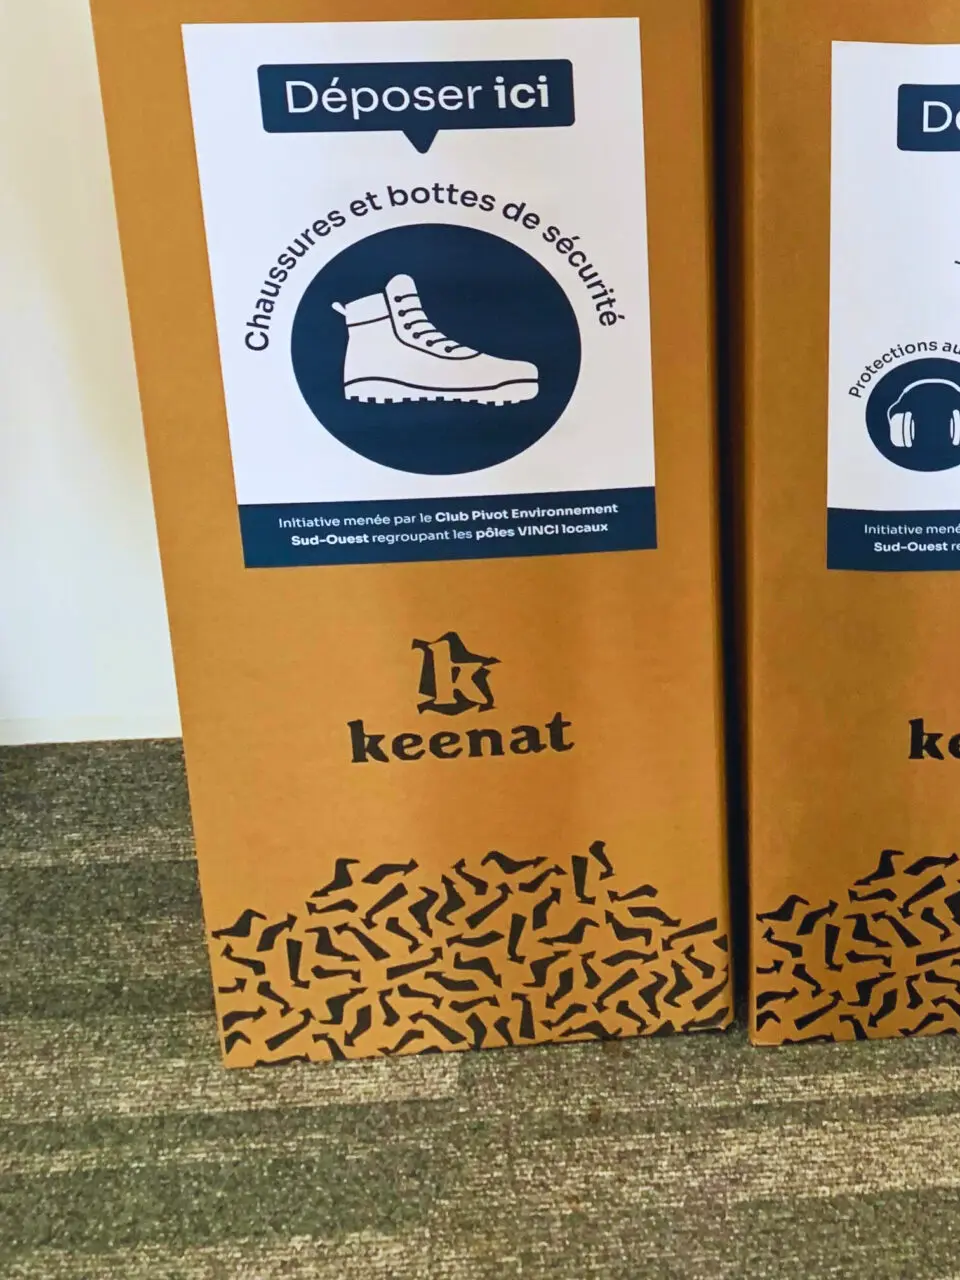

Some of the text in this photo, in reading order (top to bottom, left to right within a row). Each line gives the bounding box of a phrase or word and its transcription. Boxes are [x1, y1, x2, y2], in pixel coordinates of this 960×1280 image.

[284, 75, 550, 120] Déposer ici
[244, 182, 625, 352] Chaussures et bottes de sécurité
[848, 340, 938, 399] Protections
[278, 503, 619, 528] Initiative menée par le Club Pivot Environnement
[864, 523, 923, 535] Initiative
[291, 521, 608, 547] Sud-Ouest regroupant les pôles VINCI locaux
[874, 541, 948, 552] Sud-Ouest
[347, 711, 574, 763] keenat
